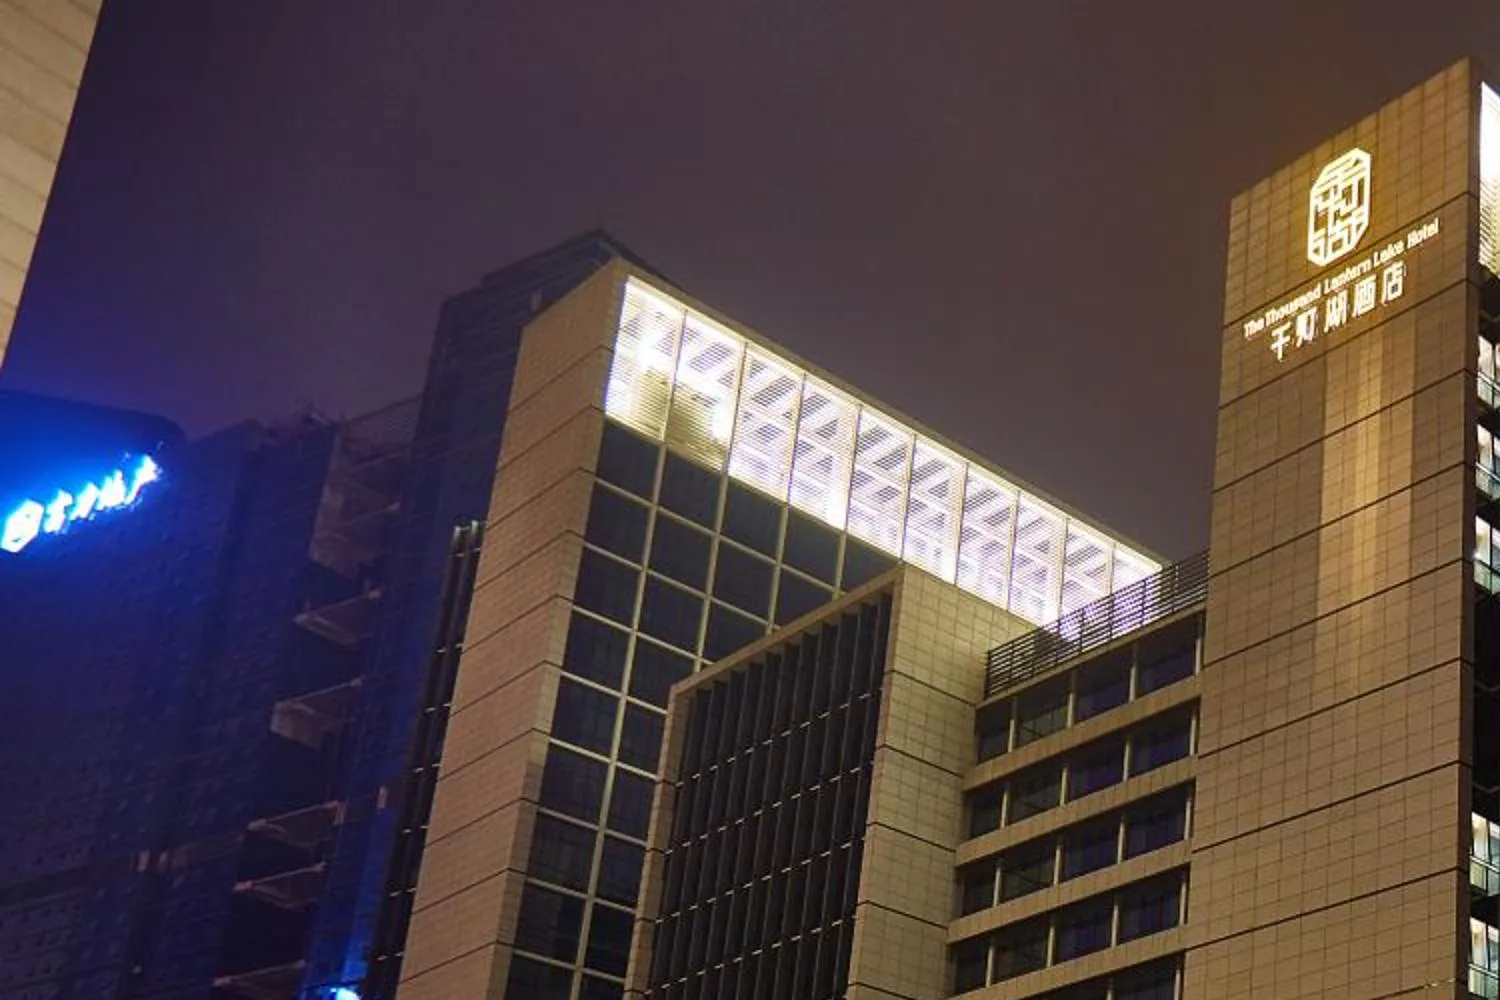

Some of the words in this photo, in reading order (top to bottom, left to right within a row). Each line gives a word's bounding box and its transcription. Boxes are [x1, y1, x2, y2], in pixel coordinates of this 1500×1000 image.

[1244, 317, 1265, 337] The
[1265, 282, 1321, 327] Thousand
[1324, 257, 1372, 293] Lantern
[1373, 239, 1405, 267] Lake
[1407, 217, 1440, 249] Hotel
